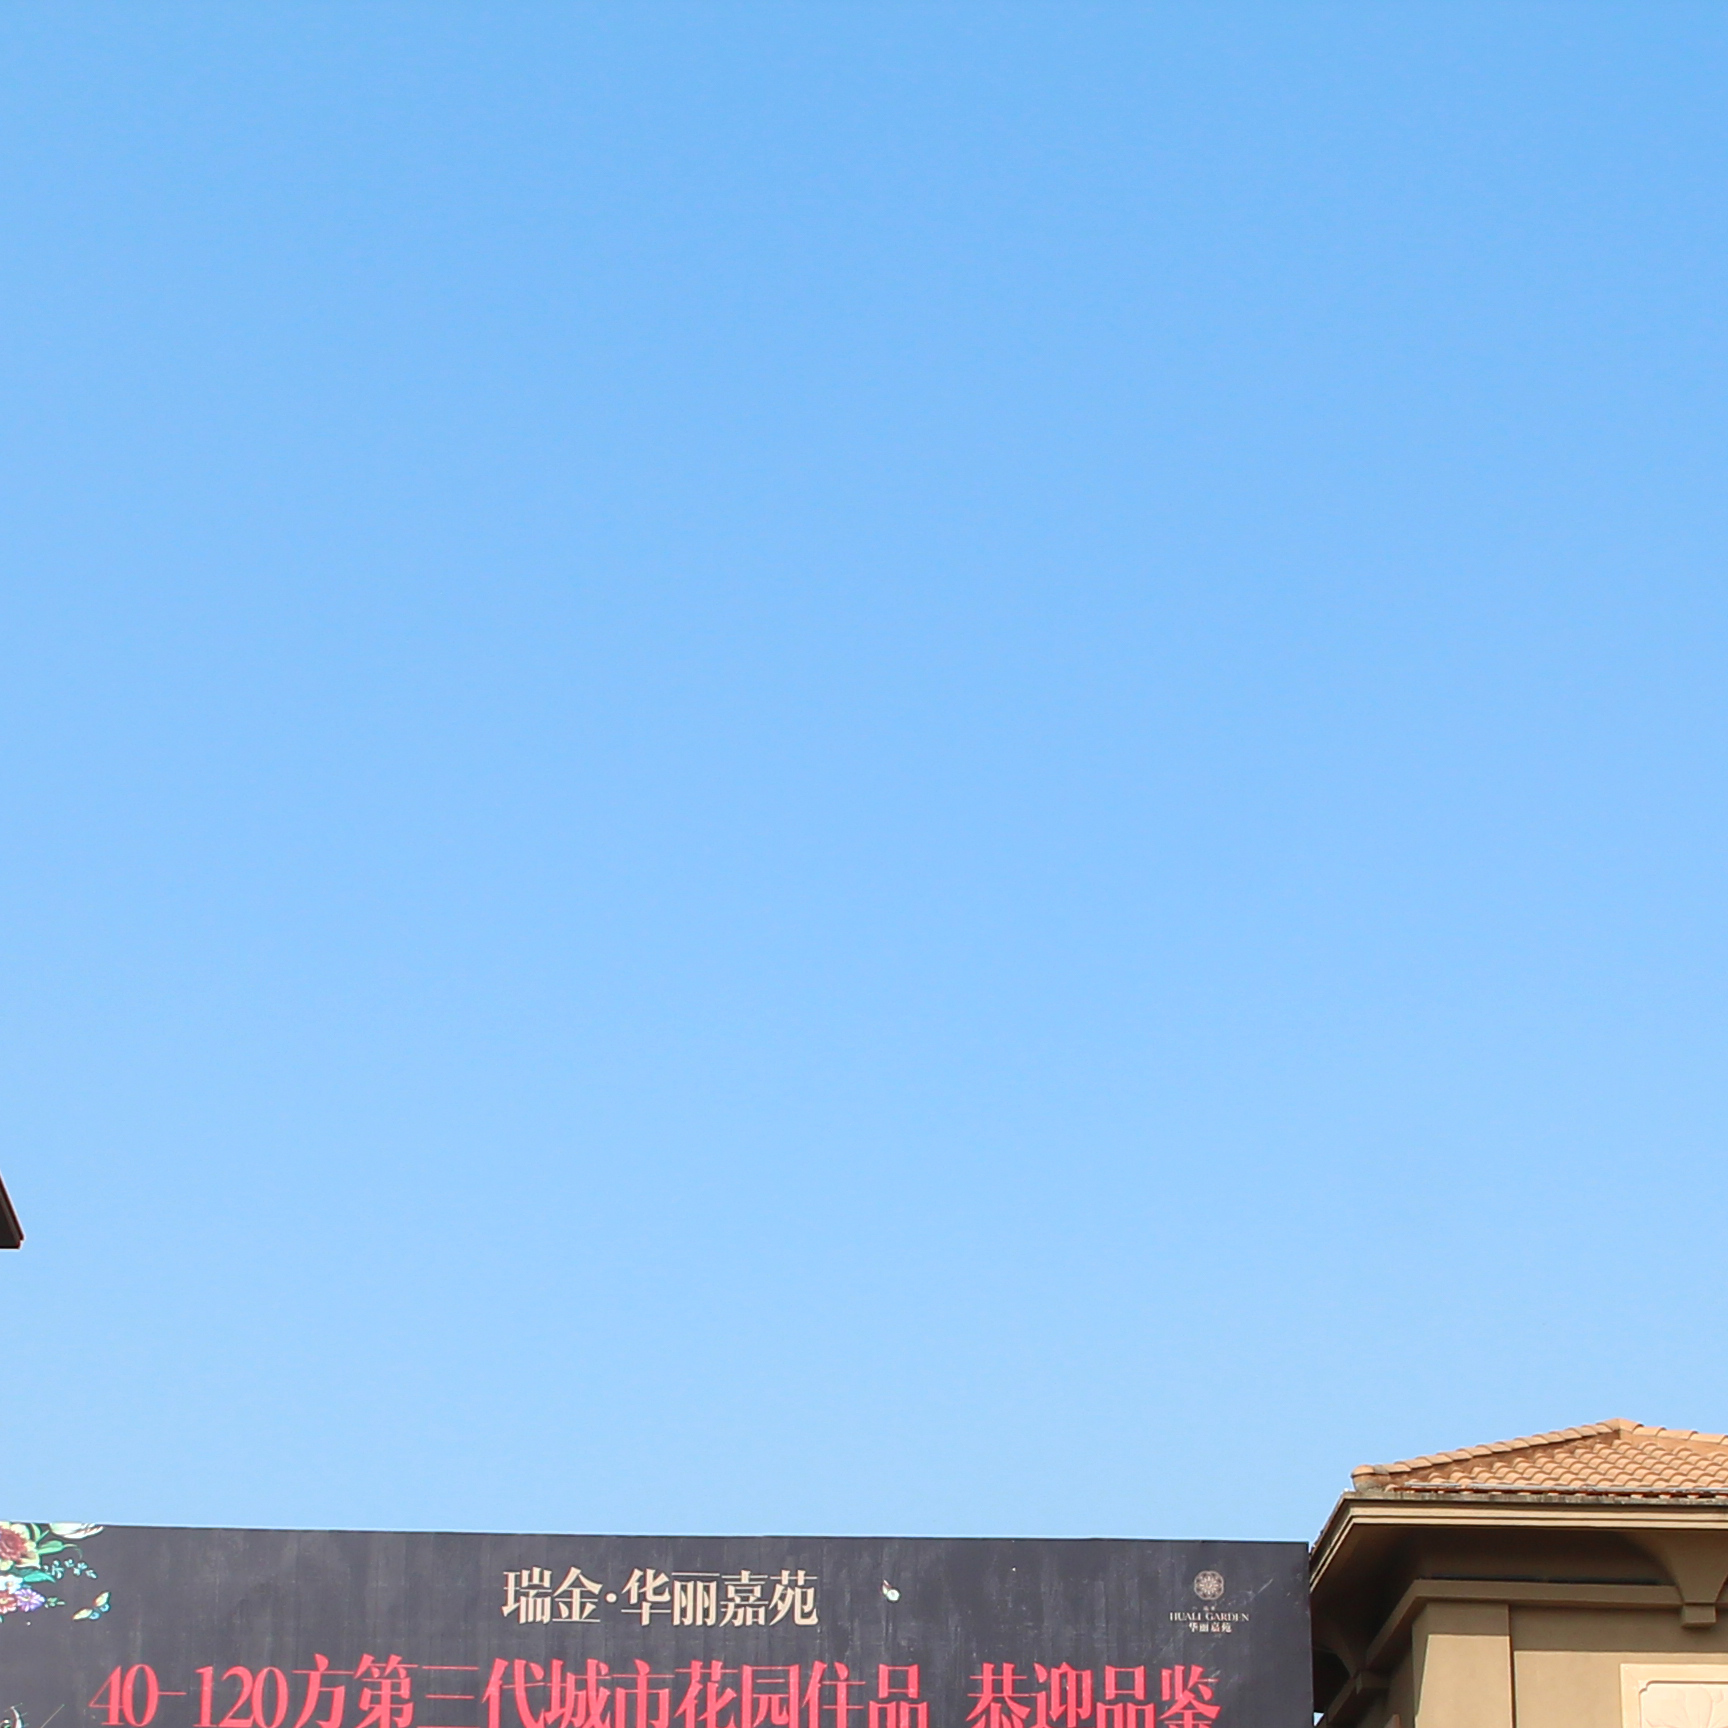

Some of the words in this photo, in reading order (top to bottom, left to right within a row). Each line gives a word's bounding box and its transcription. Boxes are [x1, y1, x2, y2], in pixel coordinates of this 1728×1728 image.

[501, 1566, 819, 1627] 瑞金·华丽嘉苑
